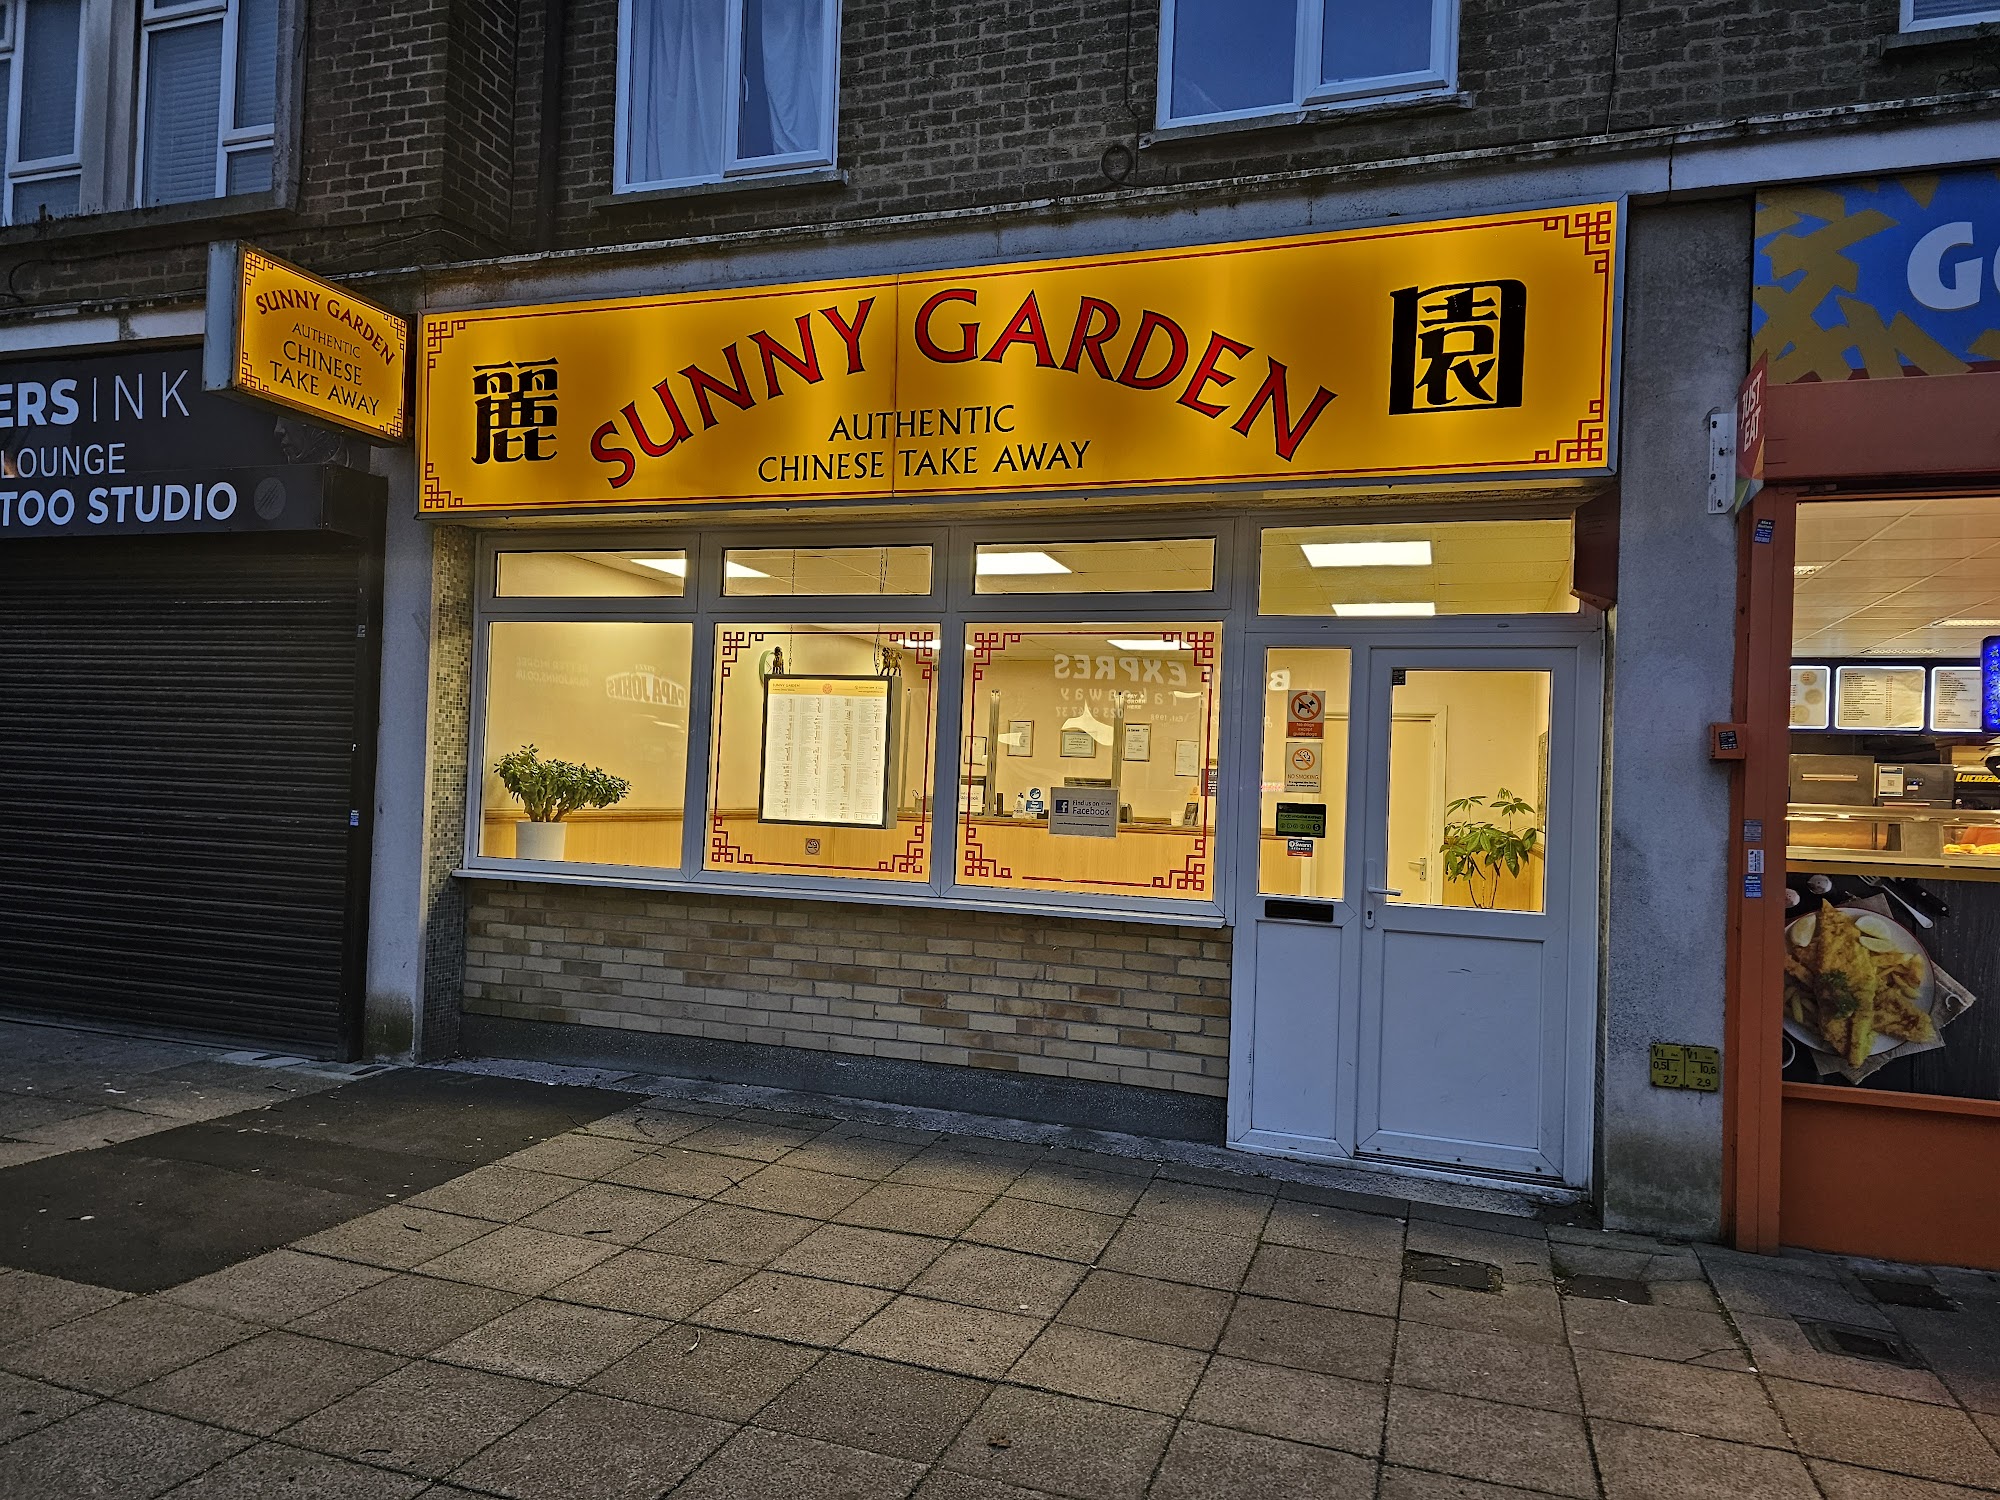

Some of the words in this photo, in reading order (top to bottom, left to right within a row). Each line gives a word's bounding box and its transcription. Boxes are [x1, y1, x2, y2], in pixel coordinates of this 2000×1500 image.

[1905, 221, 2000, 311] G
[255, 289, 321, 315] SUNNY
[327, 299, 396, 366] GARDEN
[291, 322, 361, 359] AUTHENTIC
[1388, 278, 1528, 416] 園
[283, 340, 362, 386] CHINESE
[92, 369, 190, 422] INK
[269, 360, 320, 396] TAKE
[327, 384, 380, 416] AWAY
[590, 295, 877, 490] SUNNY
[913, 287, 1339, 463] GARDEN
[1740, 370, 1763, 429] JUST
[471, 357, 559, 466] 麗
[828, 404, 1016, 442] AUTHENTIC
[1744, 405, 1762, 453] EAT
[1, 443, 126, 479] LOUNGE
[757, 451, 885, 483] CHINESE
[898, 446, 978, 477] TAKE
[992, 440, 1092, 473] AWAY
[87, 481, 238, 525] STUDIO
[1955, 772, 2000, 783] Lucoza
[1072, 807, 1110, 816] Facebook
[1663, 1075, 1677, 1085] 2.7
[1696, 1078, 1711, 1087] 2.9
